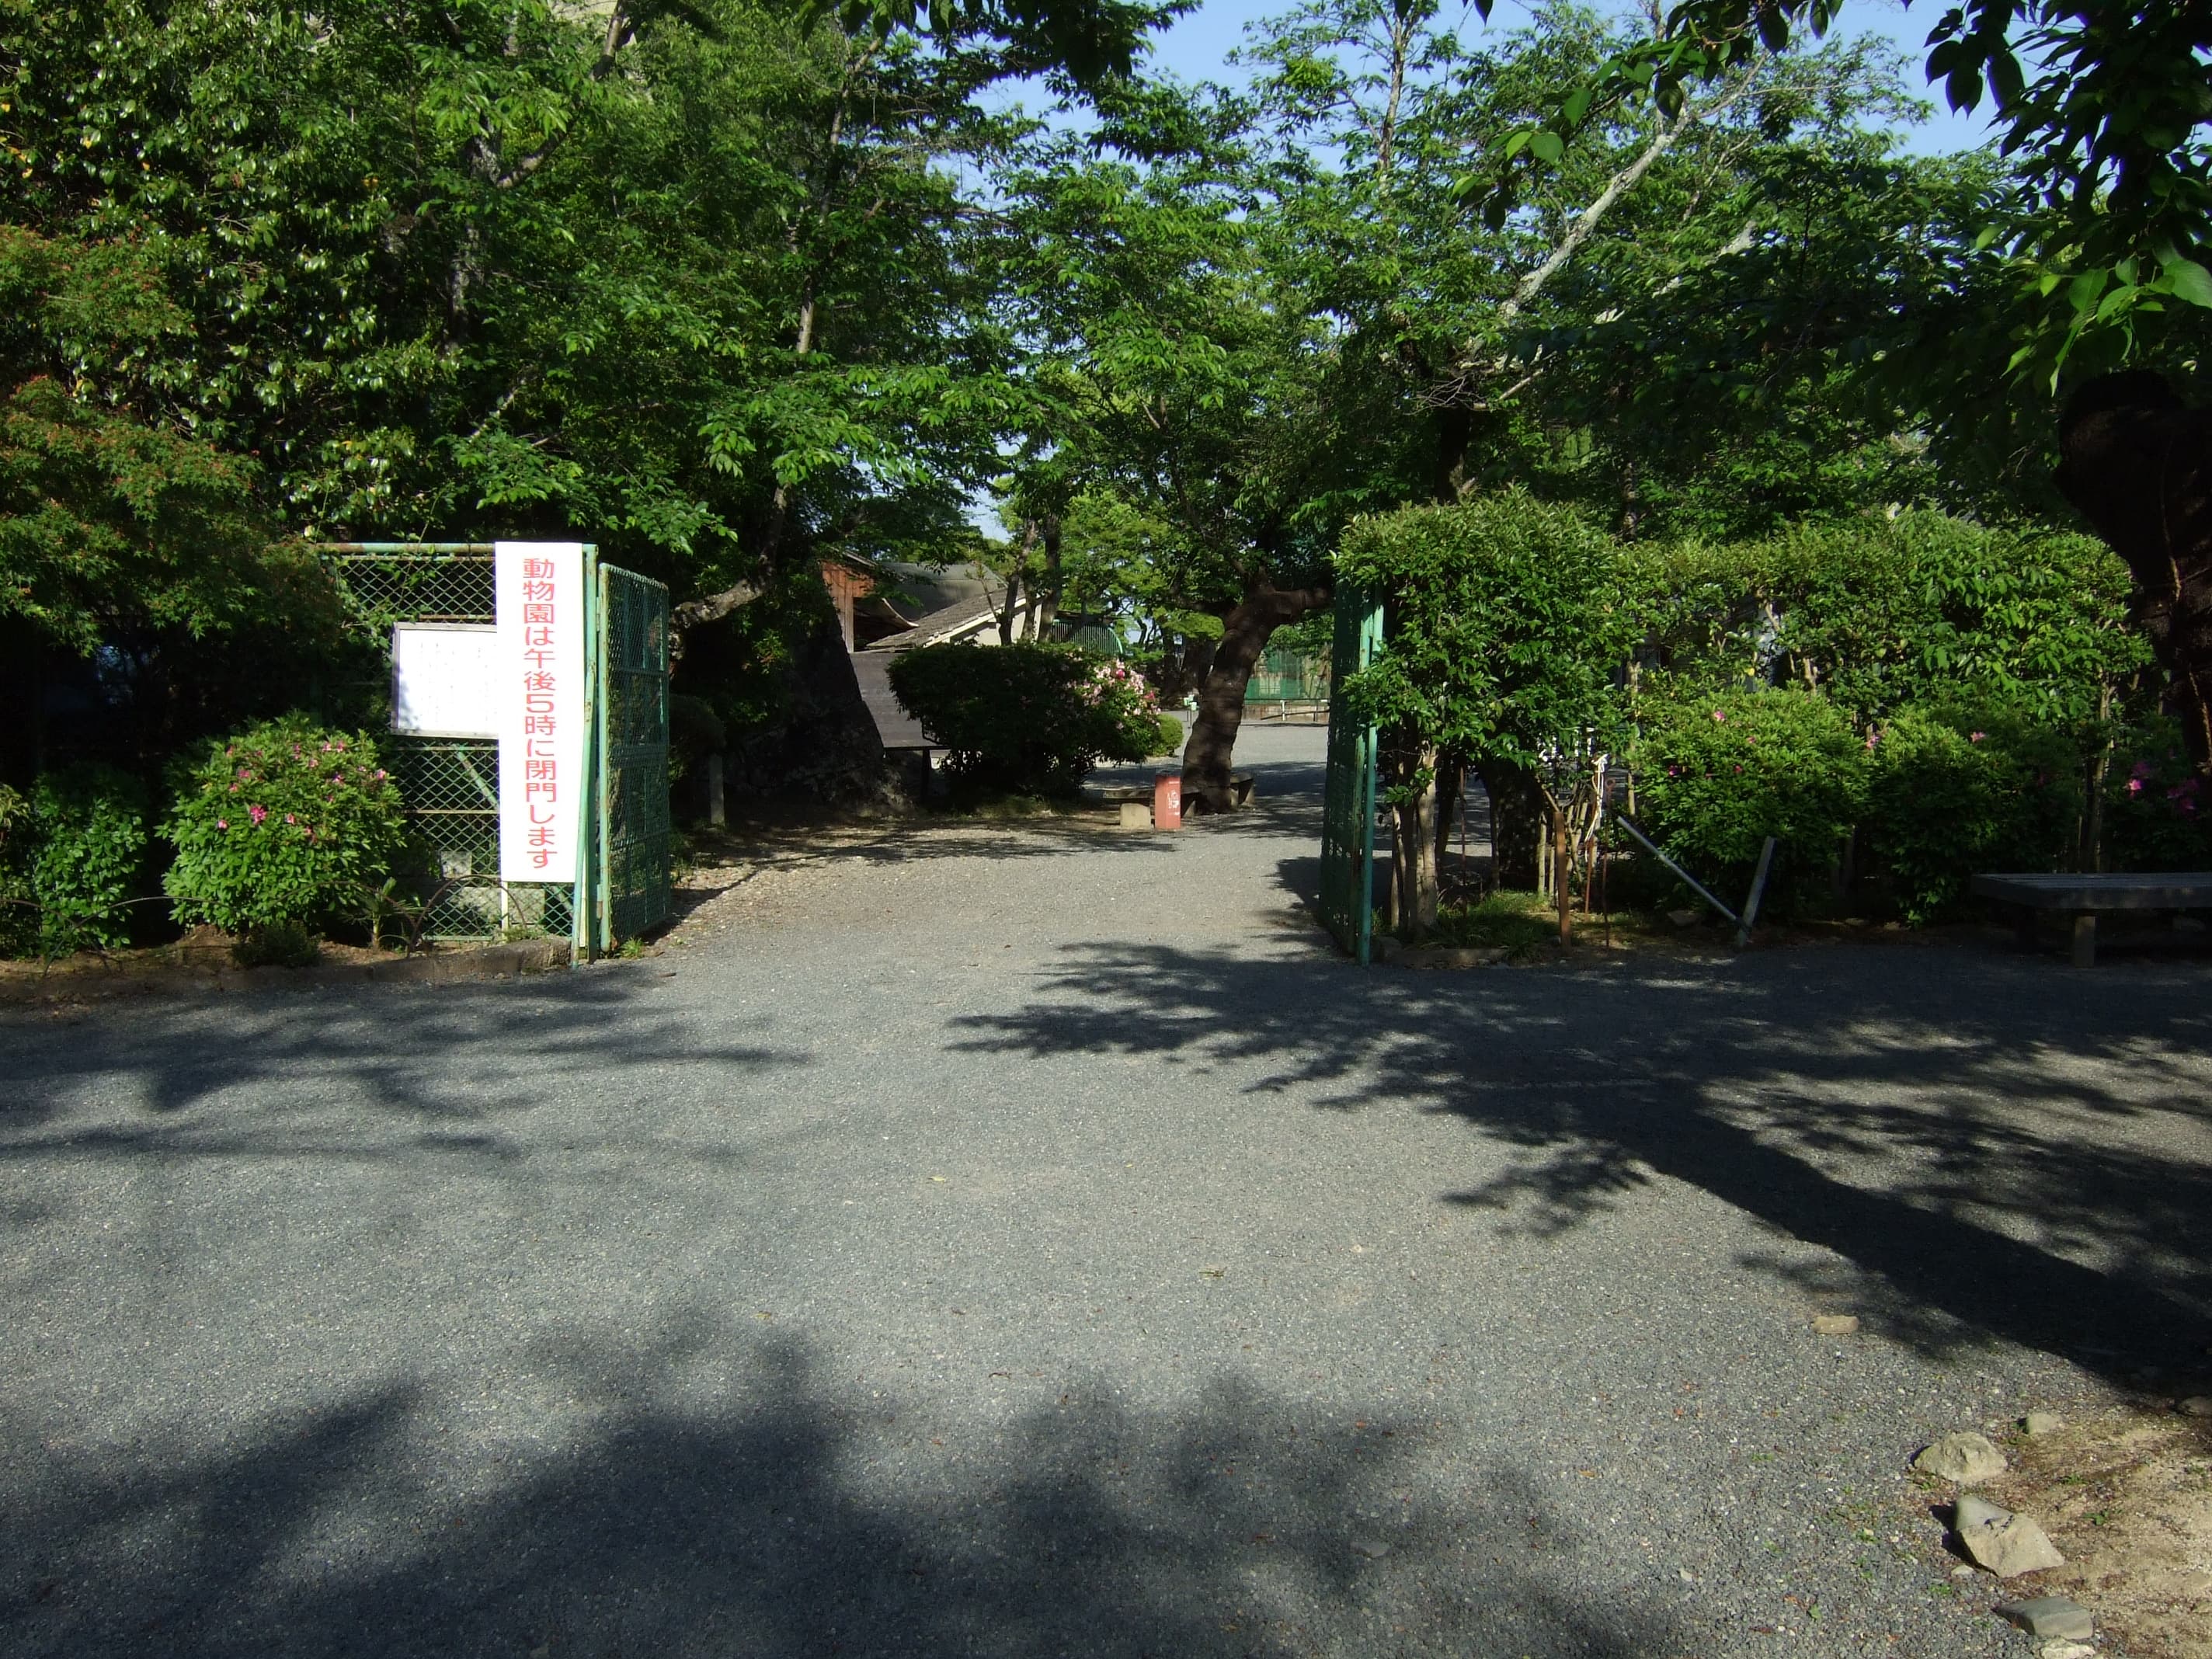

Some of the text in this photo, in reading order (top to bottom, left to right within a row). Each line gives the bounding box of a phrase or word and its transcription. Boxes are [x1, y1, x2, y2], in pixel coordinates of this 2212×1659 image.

[522, 558, 558, 868] 動物園は午後5時に閉門します
